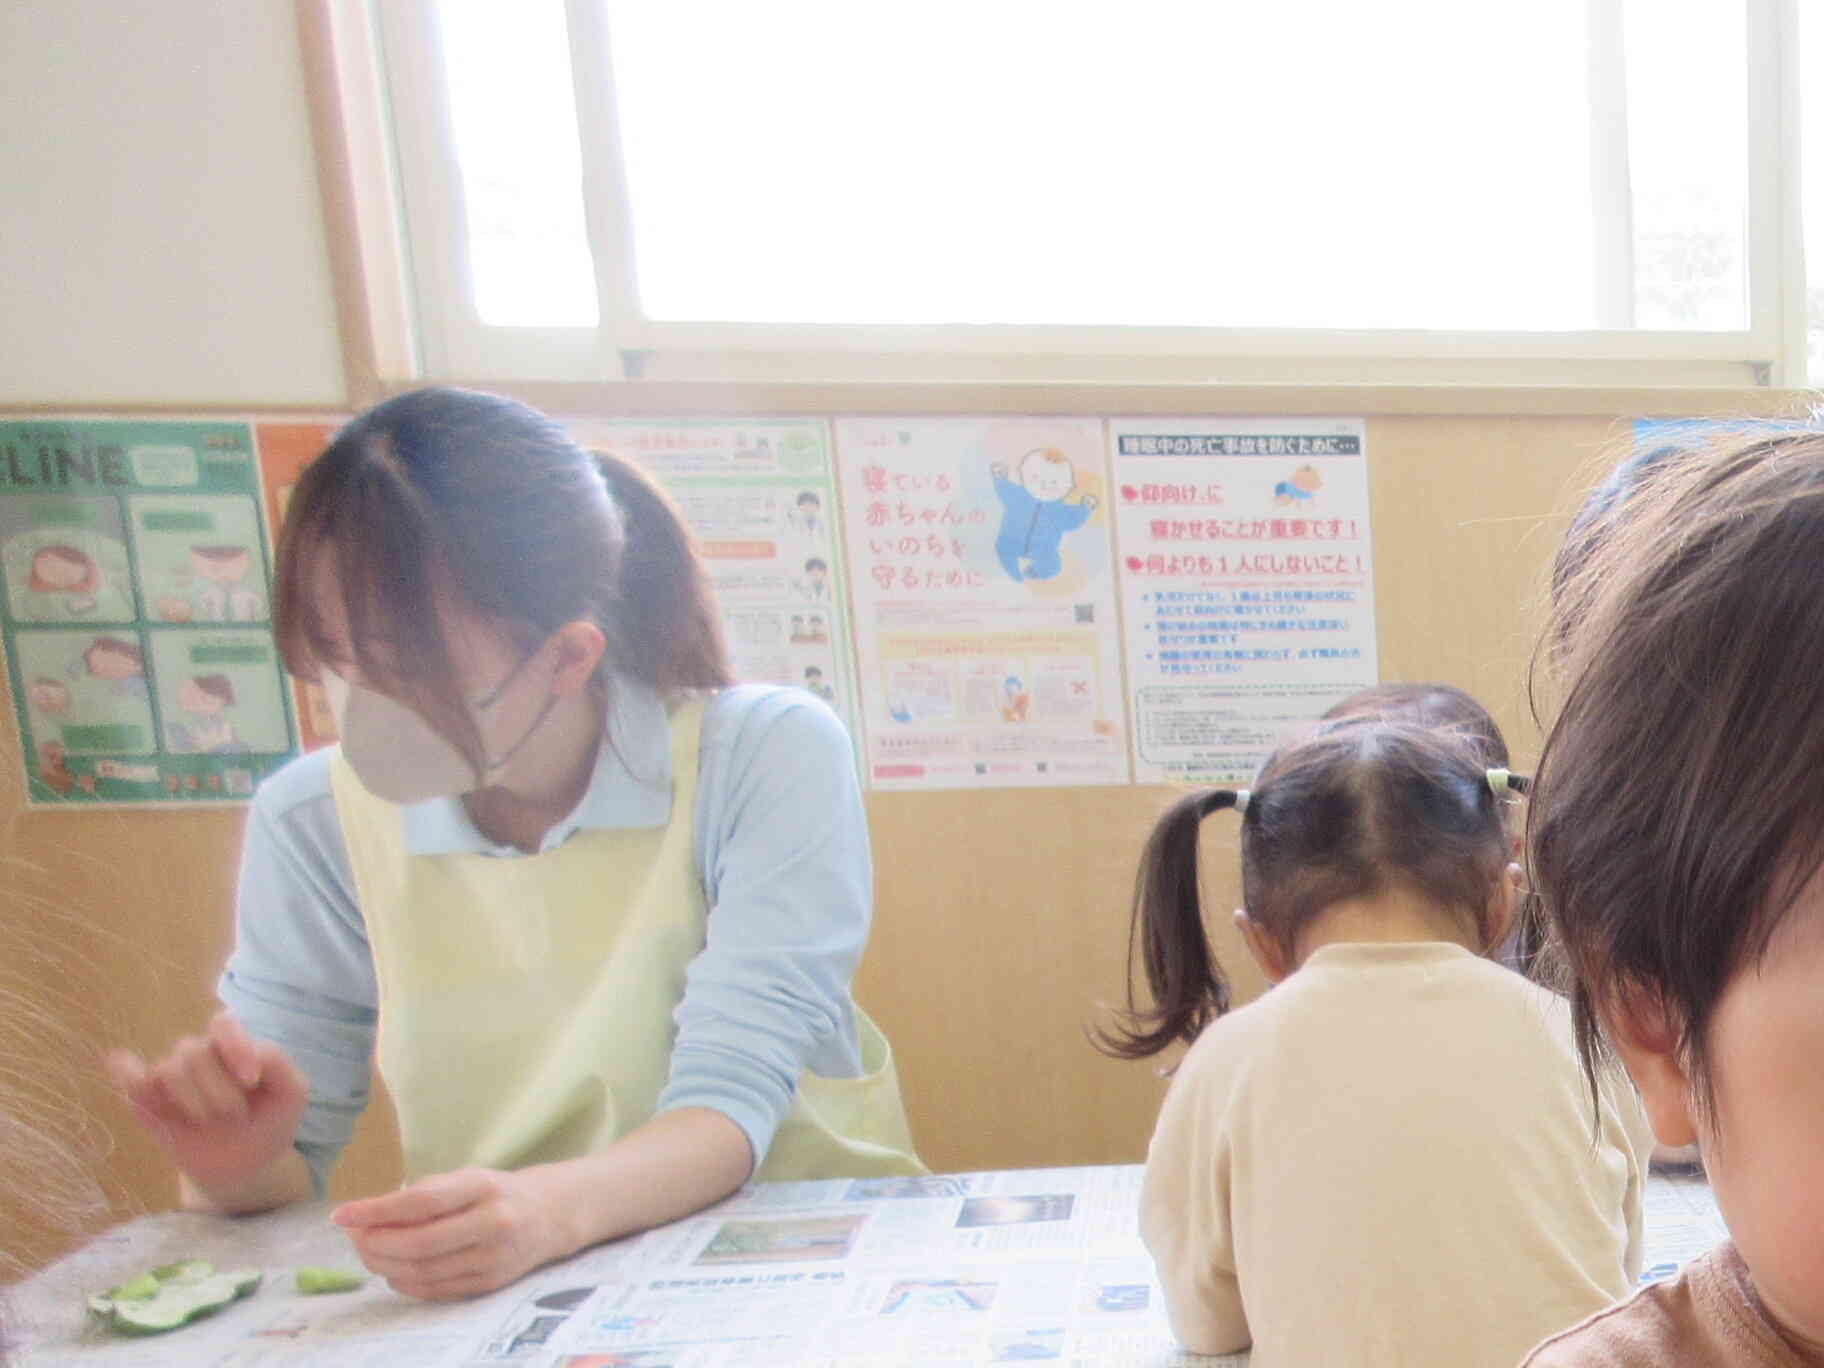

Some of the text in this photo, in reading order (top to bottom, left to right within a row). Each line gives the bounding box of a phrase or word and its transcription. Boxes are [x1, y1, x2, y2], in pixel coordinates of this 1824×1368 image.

[0, 444, 128, 486] LINE
[863, 466, 951, 492] 寝ている
[866, 502, 985, 526] 赤ちゃんの
[869, 535, 966, 557] いのちを
[872, 564, 985, 590] 守るために
